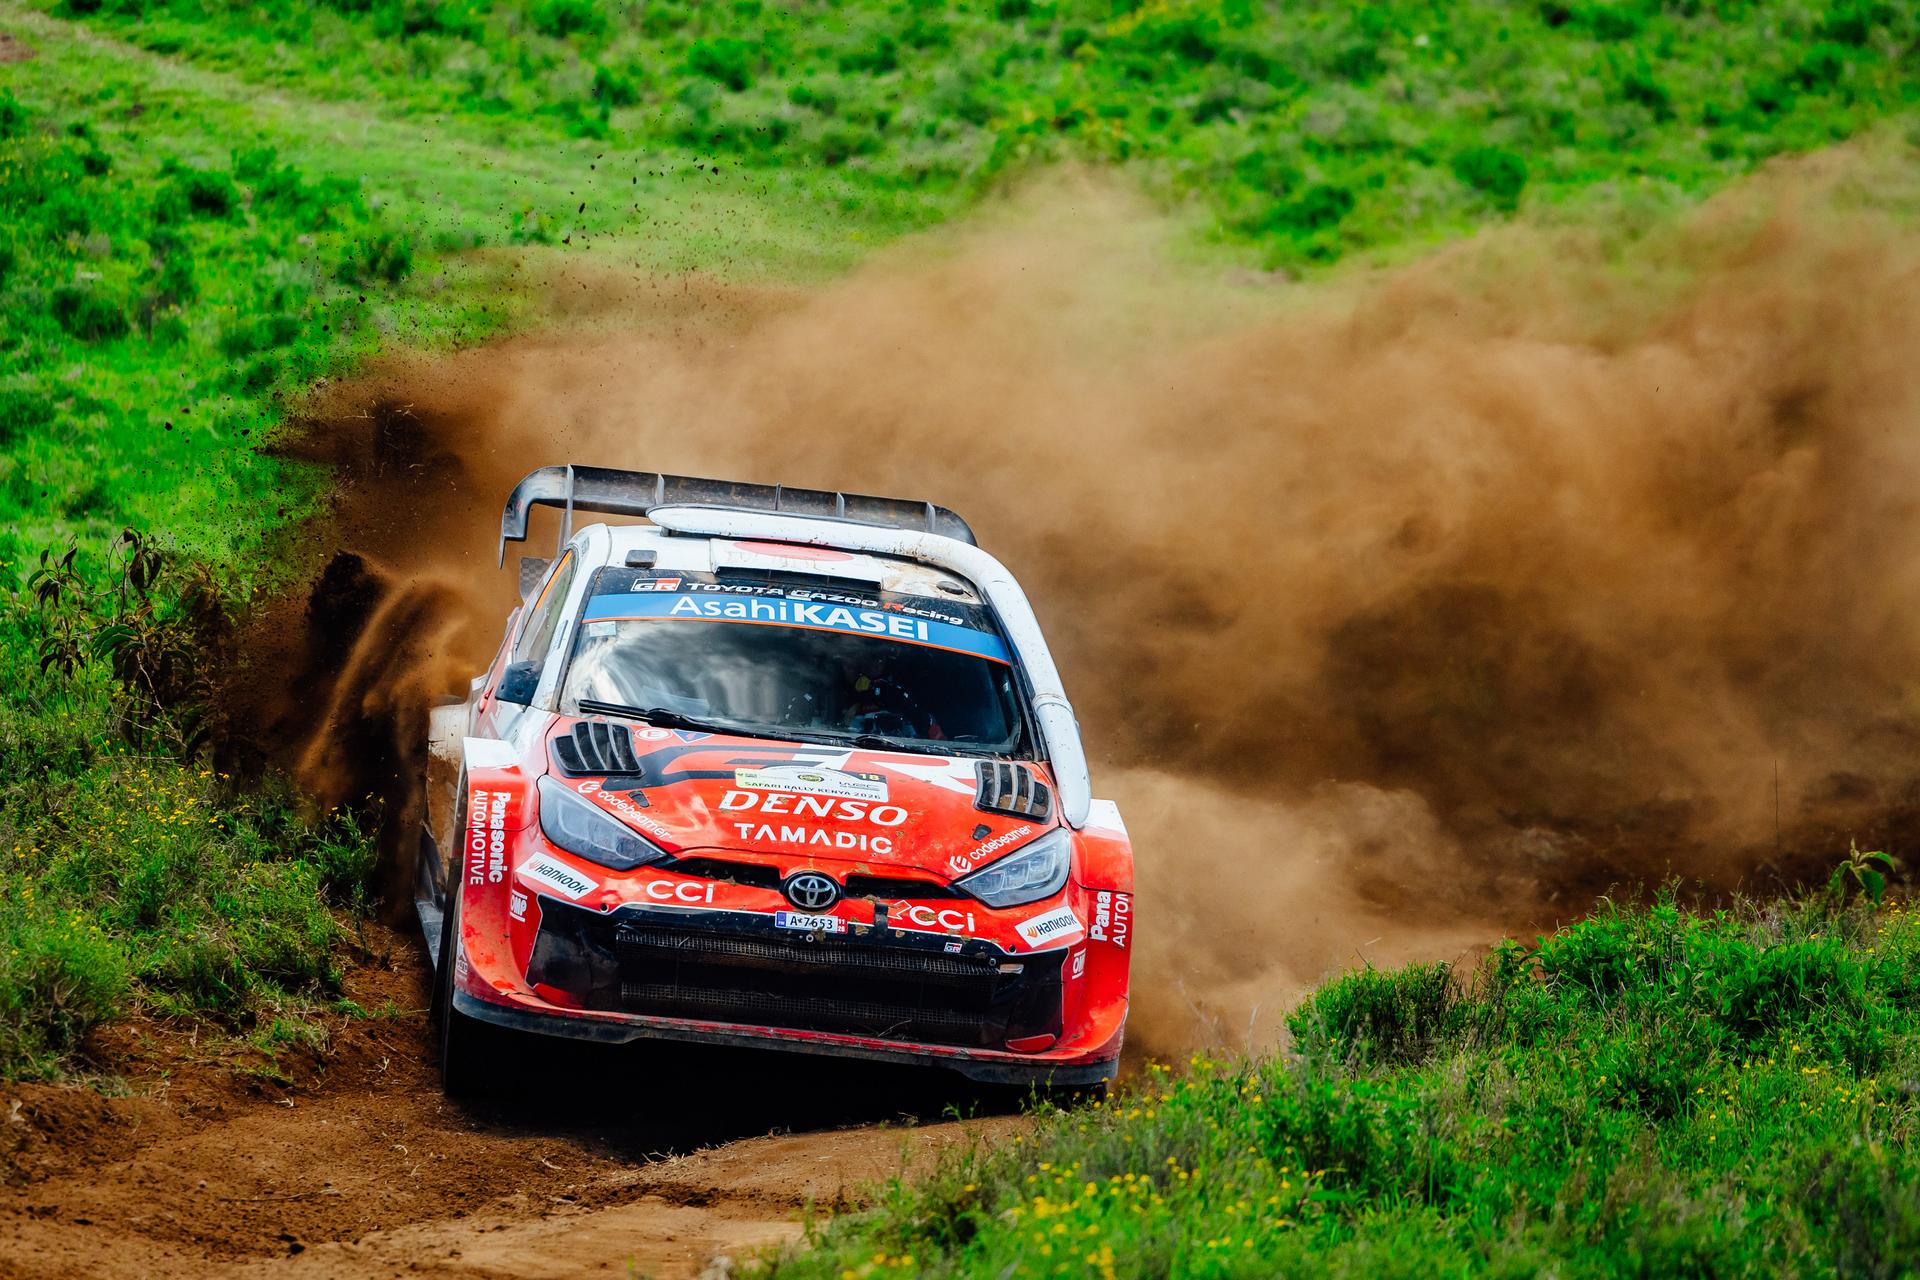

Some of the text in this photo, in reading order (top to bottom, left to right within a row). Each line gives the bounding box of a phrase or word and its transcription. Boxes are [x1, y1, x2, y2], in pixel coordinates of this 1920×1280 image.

[686, 583, 783, 595] TOYOTA
[787, 588, 879, 607] GAZOO
[883, 601, 964, 625] Racing
[718, 790, 908, 826] DENSO
[744, 781, 781, 789] SAFARI
[784, 785, 814, 793] RALLY
[818, 787, 851, 796] KENYA
[597, 790, 672, 839] codebeamer
[470, 789, 488, 886] AUTOMOTIVE
[489, 792, 511, 883] Panasonic
[734, 822, 893, 854] TAMADIC
[969, 825, 1031, 861] codebeamer
[1090, 891, 1111, 942] Pana
